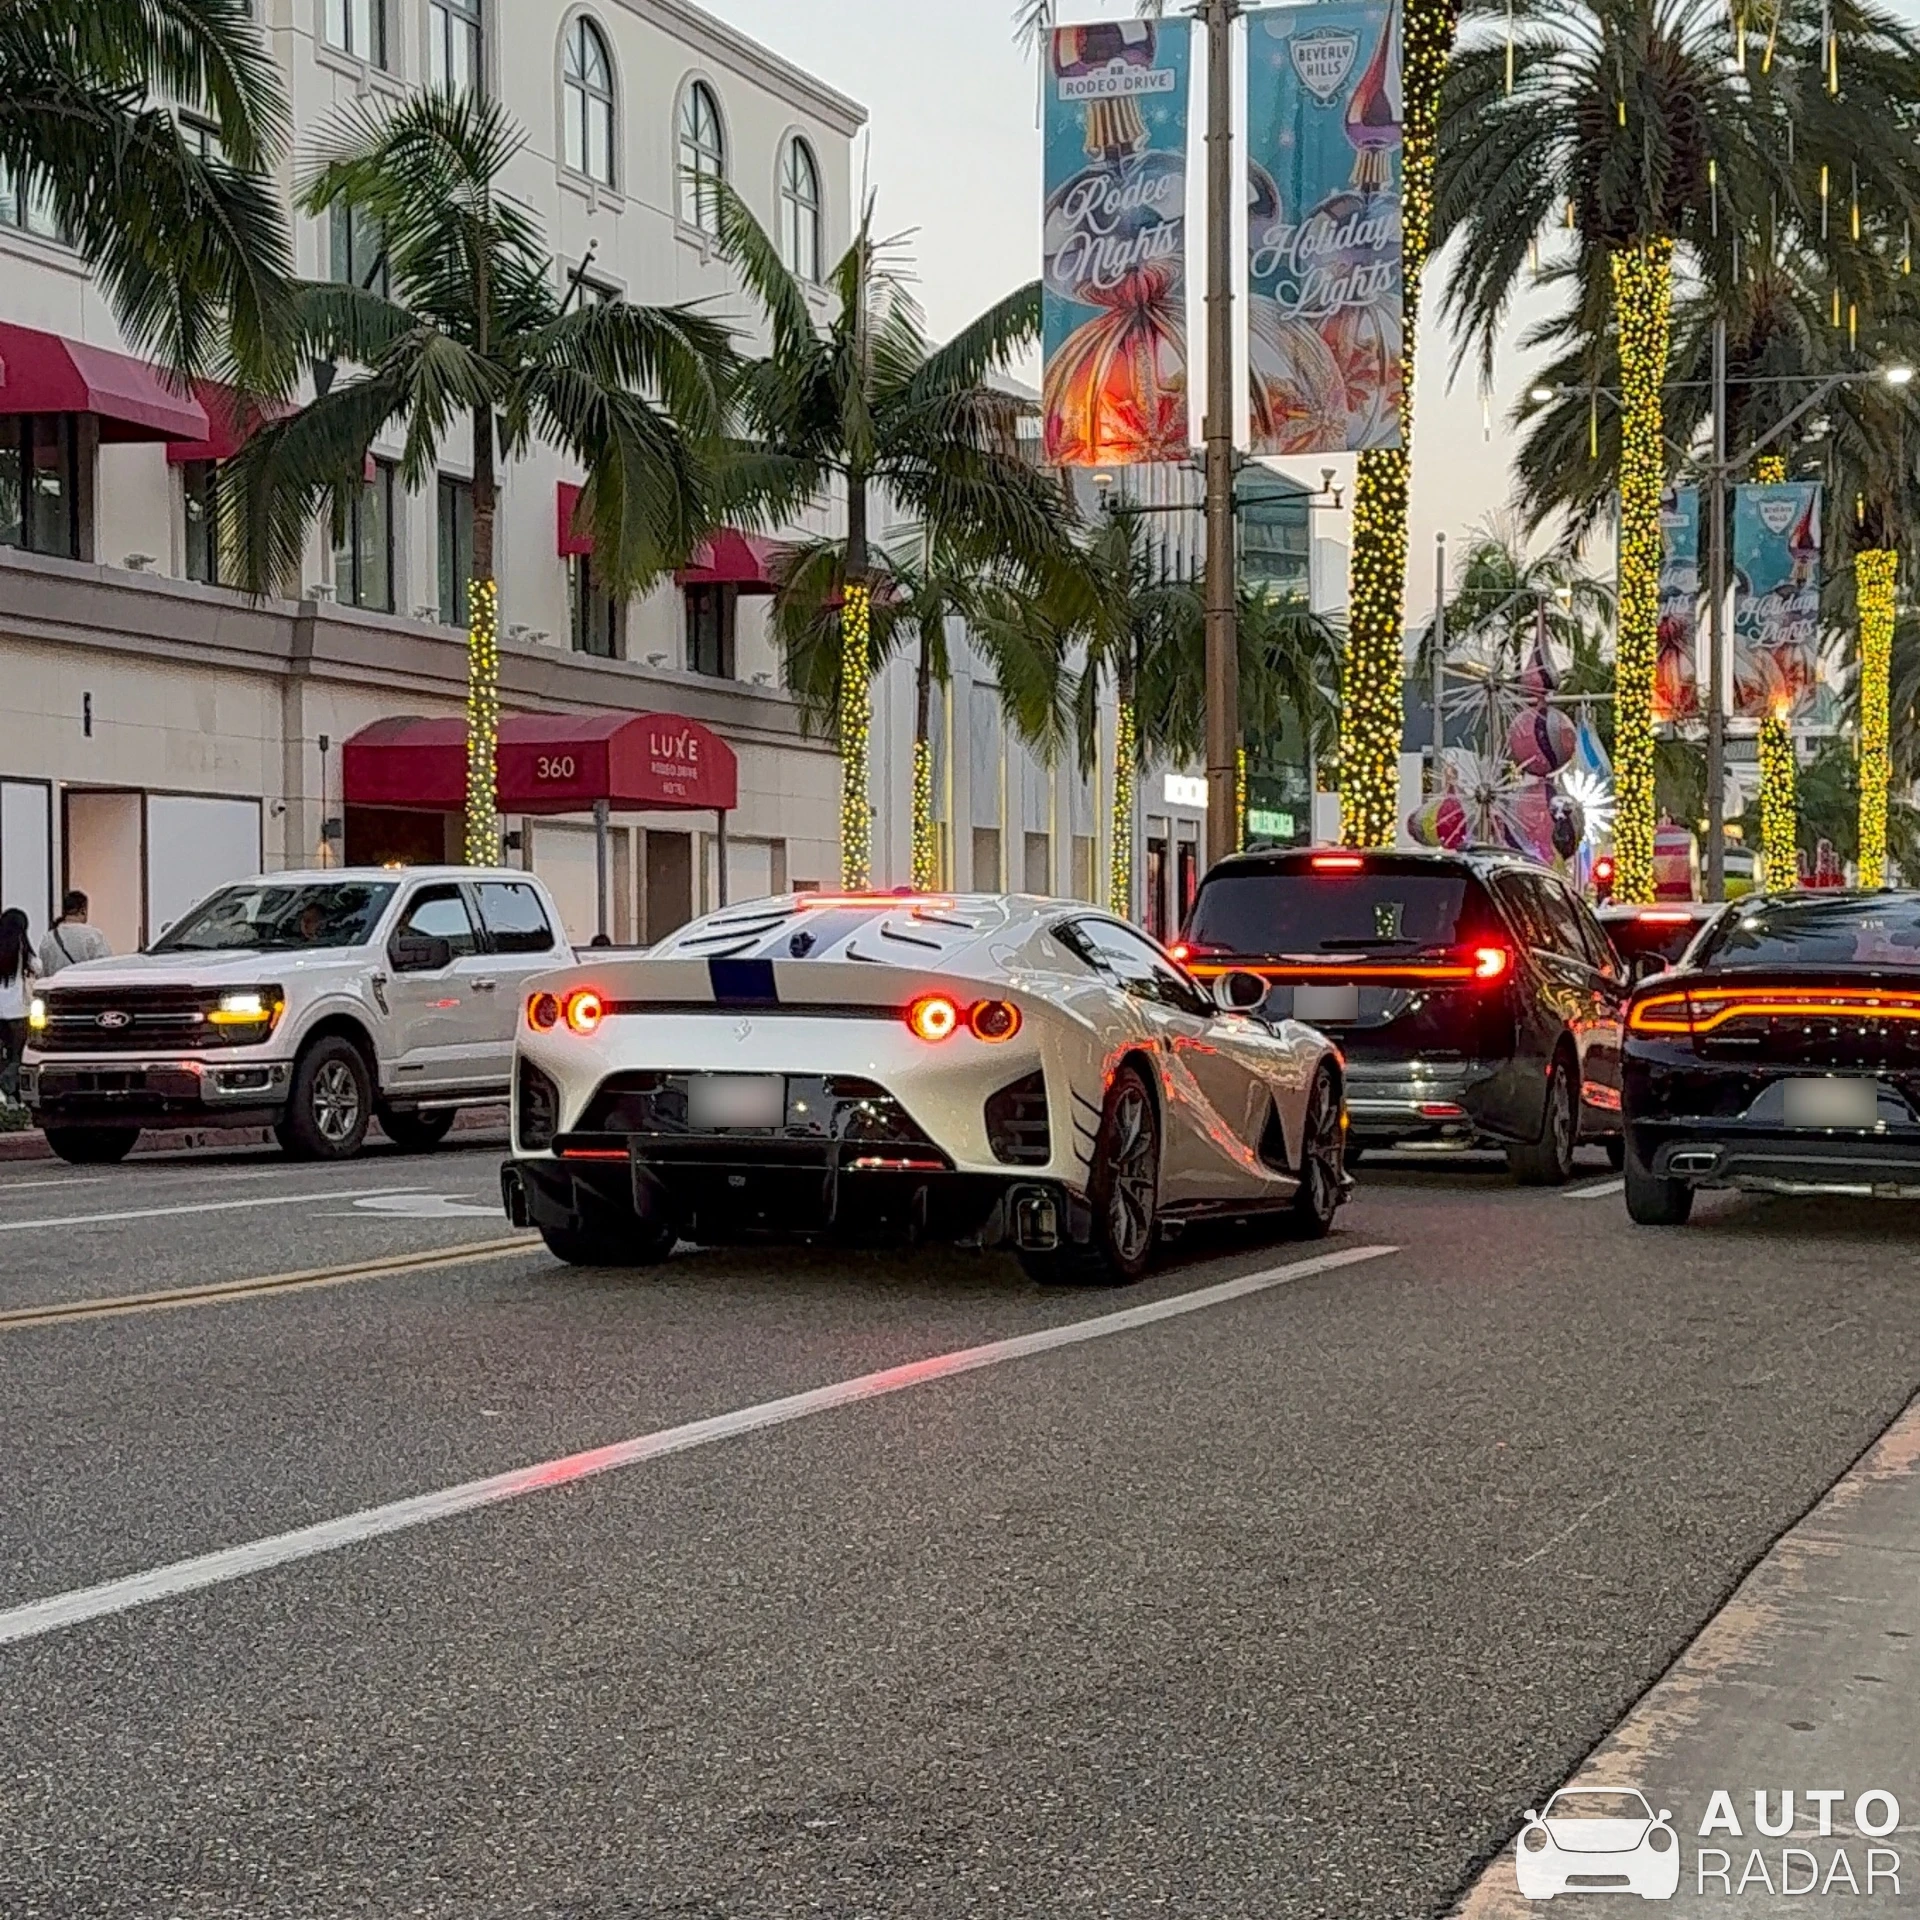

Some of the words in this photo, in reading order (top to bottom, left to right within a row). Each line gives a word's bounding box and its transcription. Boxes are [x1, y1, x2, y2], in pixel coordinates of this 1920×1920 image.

[1298, 45, 1350, 62] BEVERLY
[1306, 60, 1341, 77] HILLS
[1065, 77, 1117, 95] RODEO
[1123, 71, 1170, 90] DRIVE
[1063, 171, 1171, 235] Rodeo
[1053, 219, 1180, 289] Nights
[1250, 212, 1396, 278] Holiday
[1275, 257, 1399, 321] Lights
[650, 728, 698, 762] LUXE
[536, 755, 576, 779] 360
